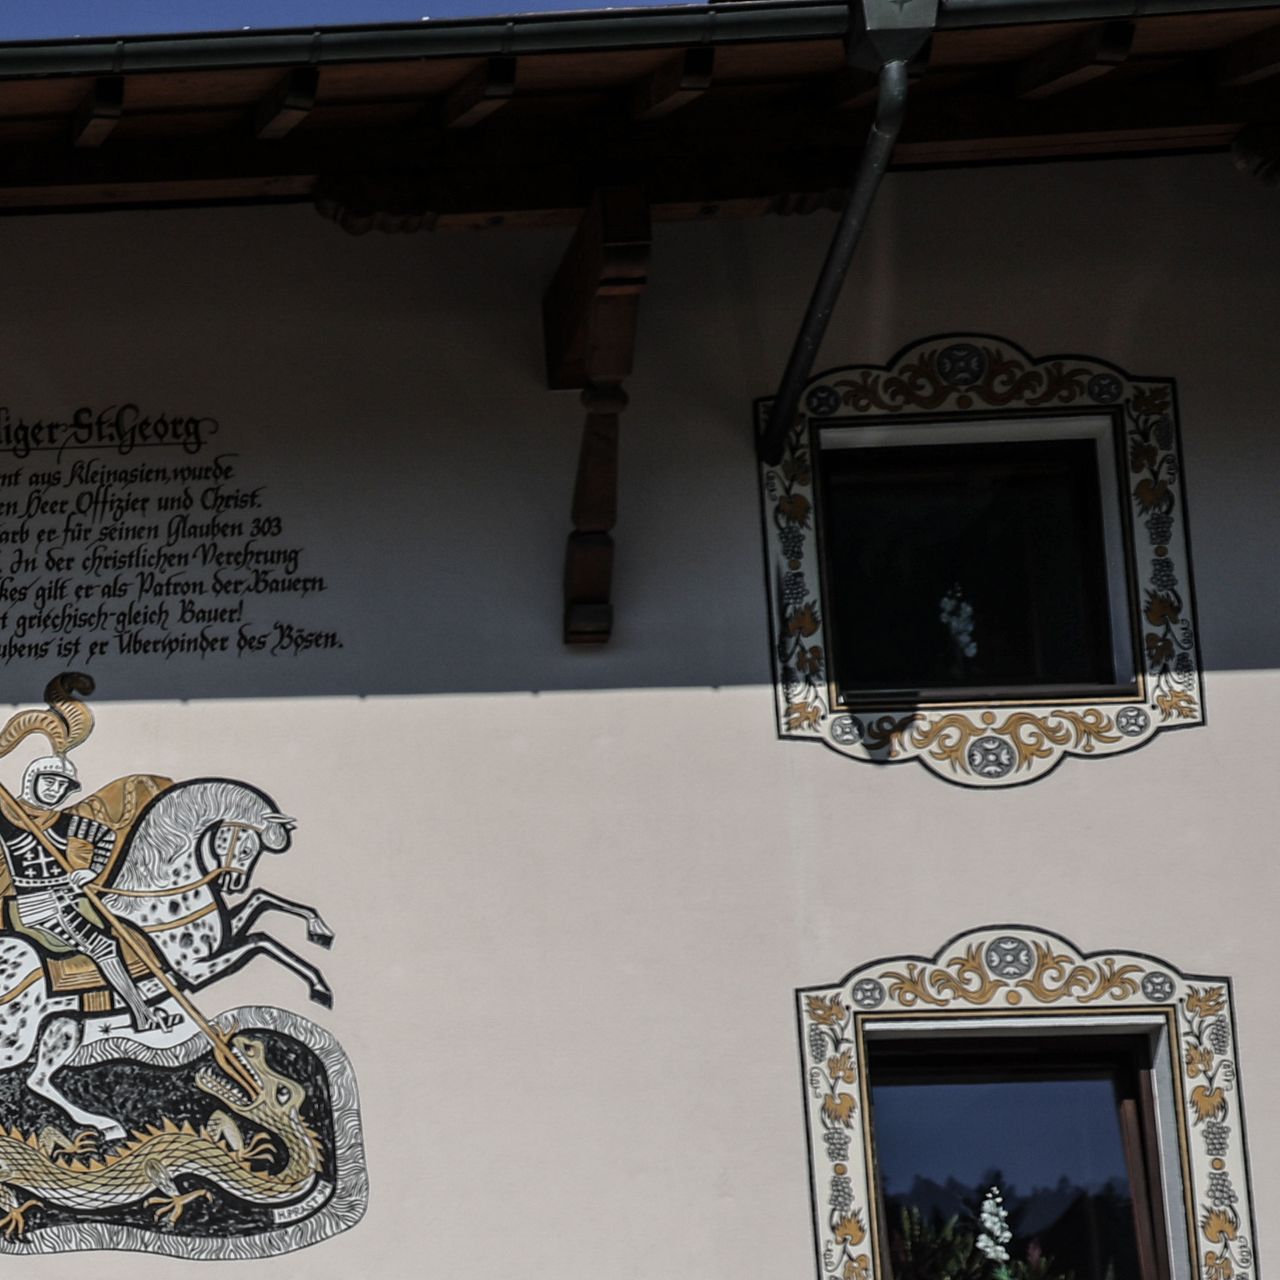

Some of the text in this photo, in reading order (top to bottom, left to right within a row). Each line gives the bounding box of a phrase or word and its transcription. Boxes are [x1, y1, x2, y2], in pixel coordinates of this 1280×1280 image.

[28, 470, 61, 491] aus
[25, 489, 68, 519] Heer
[74, 485, 149, 524] Offizier
[158, 488, 193, 511] und
[200, 486, 262, 514] Christ.
[37, 530, 57, 550] er
[62, 513, 92, 546] für
[90, 522, 158, 545] seinen
[167, 514, 243, 546] Glauben
[250, 517, 282, 537] 303
[45, 548, 74, 572] der
[82, 544, 189, 575] christlichen
[194, 541, 301, 573] Verehrung
[35, 578, 68, 608] gilt
[75, 584, 94, 601] er
[101, 574, 129, 598] als
[137, 572, 206, 601] Patron
[212, 569, 243, 596] der
[246, 570, 325, 595] Bauern
[179, 600, 244, 623] Bauer!
[57, 638, 81, 664] ist
[86, 640, 109, 662] er
[237, 624, 268, 655] des
[271, 622, 343, 655] Bösen.
